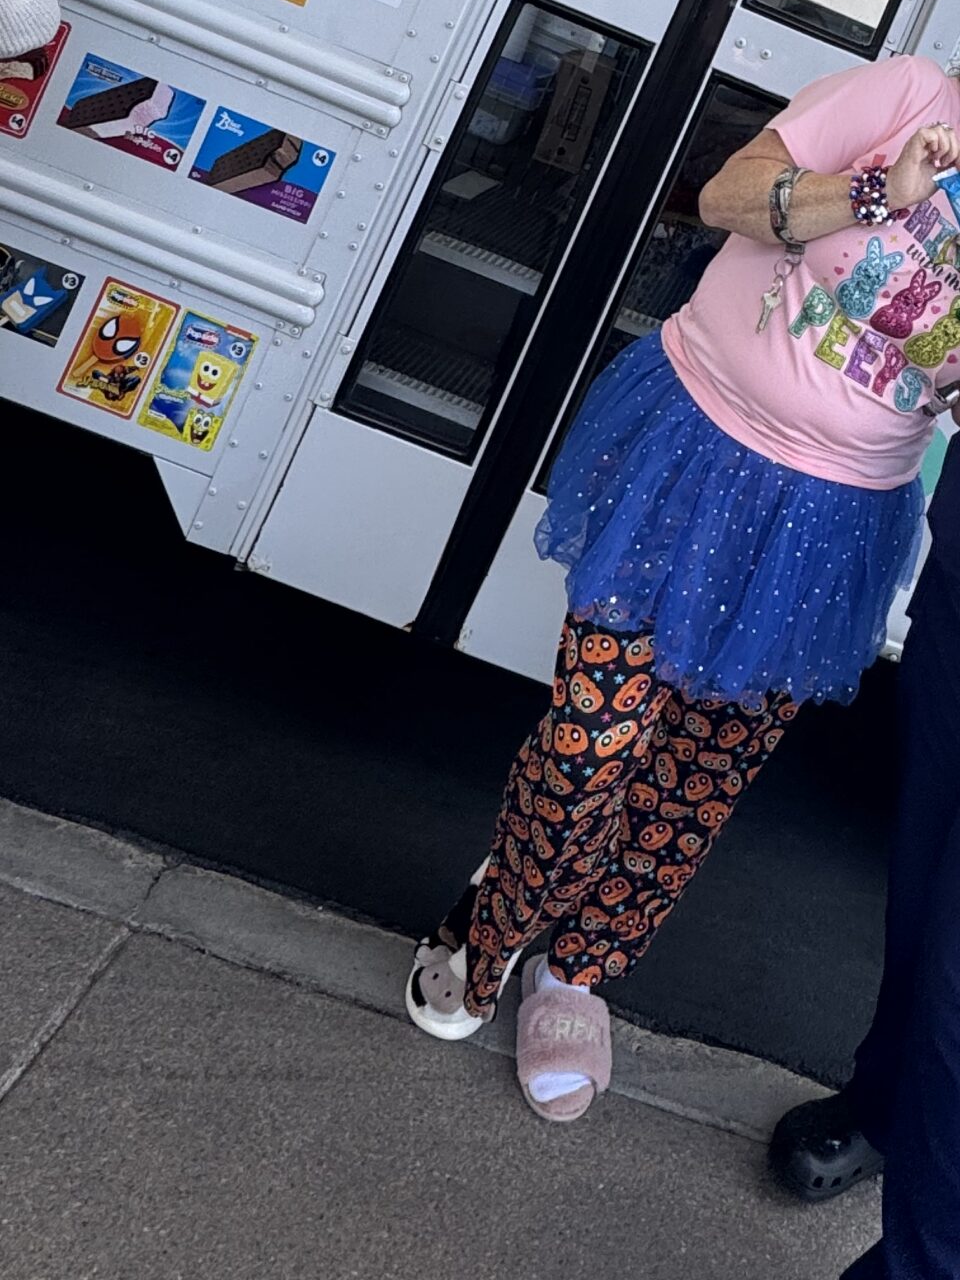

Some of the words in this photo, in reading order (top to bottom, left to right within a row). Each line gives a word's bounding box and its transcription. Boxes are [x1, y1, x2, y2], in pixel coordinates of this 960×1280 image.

[165, 149, 180, 163] $4
[314, 151, 327, 165] $4
[283, 184, 305, 199] BIG
[64, 275, 78, 288] $3
[231, 344, 245, 357] $3
[787, 283, 933, 413] PEEPS
[135, 353, 149, 367] $3
